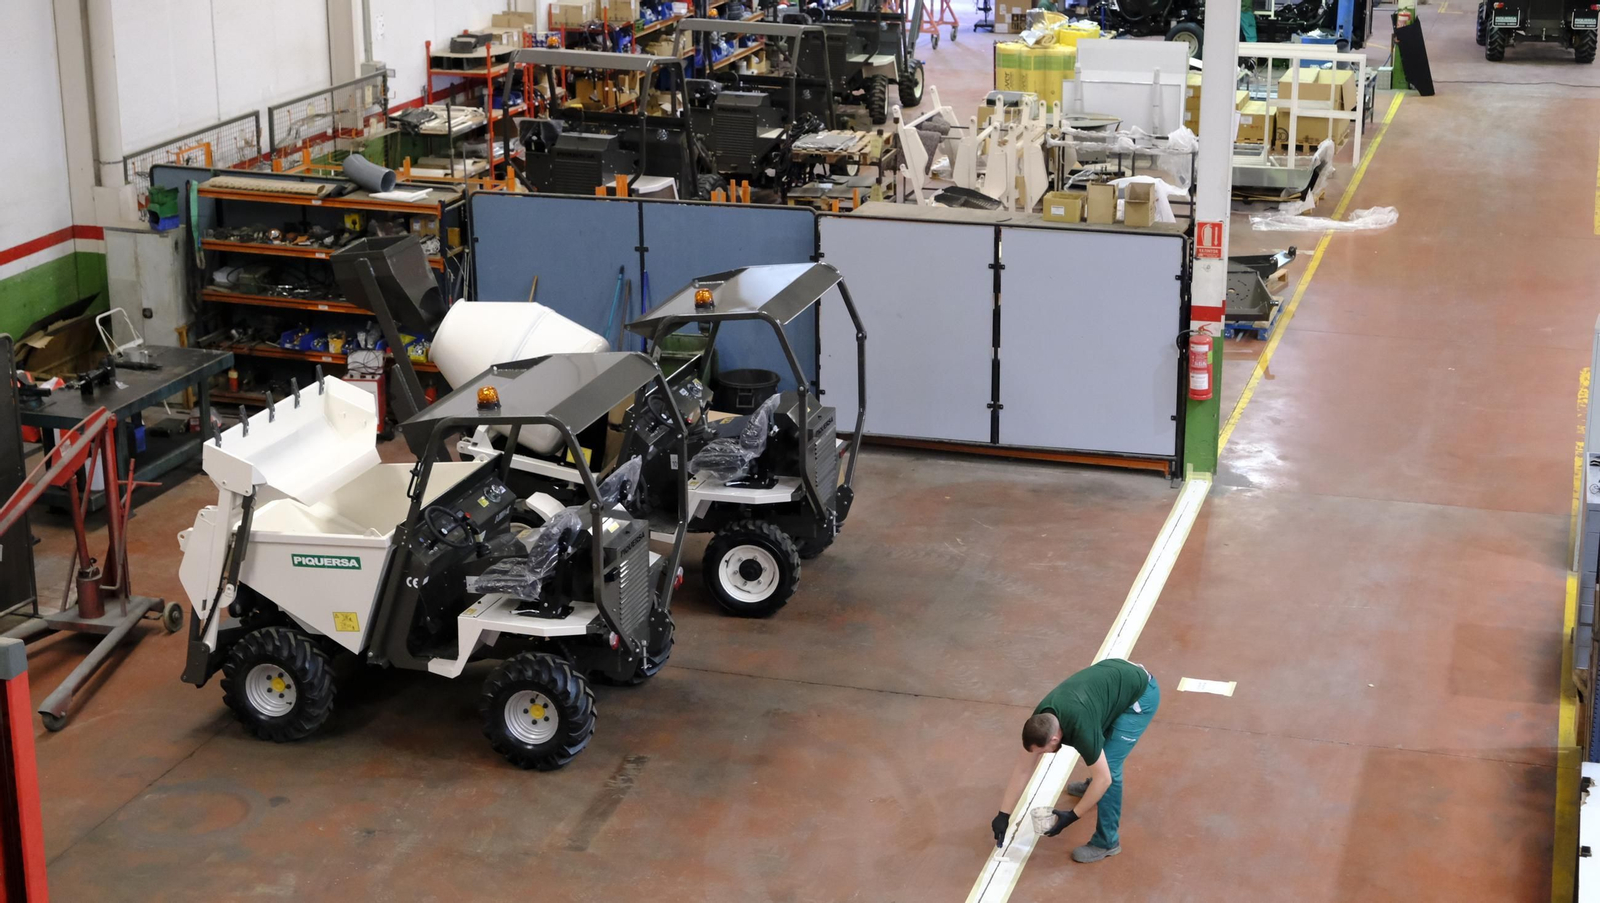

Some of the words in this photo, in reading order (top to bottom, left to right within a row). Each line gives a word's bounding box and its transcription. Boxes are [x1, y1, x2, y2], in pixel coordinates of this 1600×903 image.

[621, 531, 645, 557] PIQUERSA
[293, 556, 359, 568] PIQUERSA
[406, 576, 419, 589] CE
